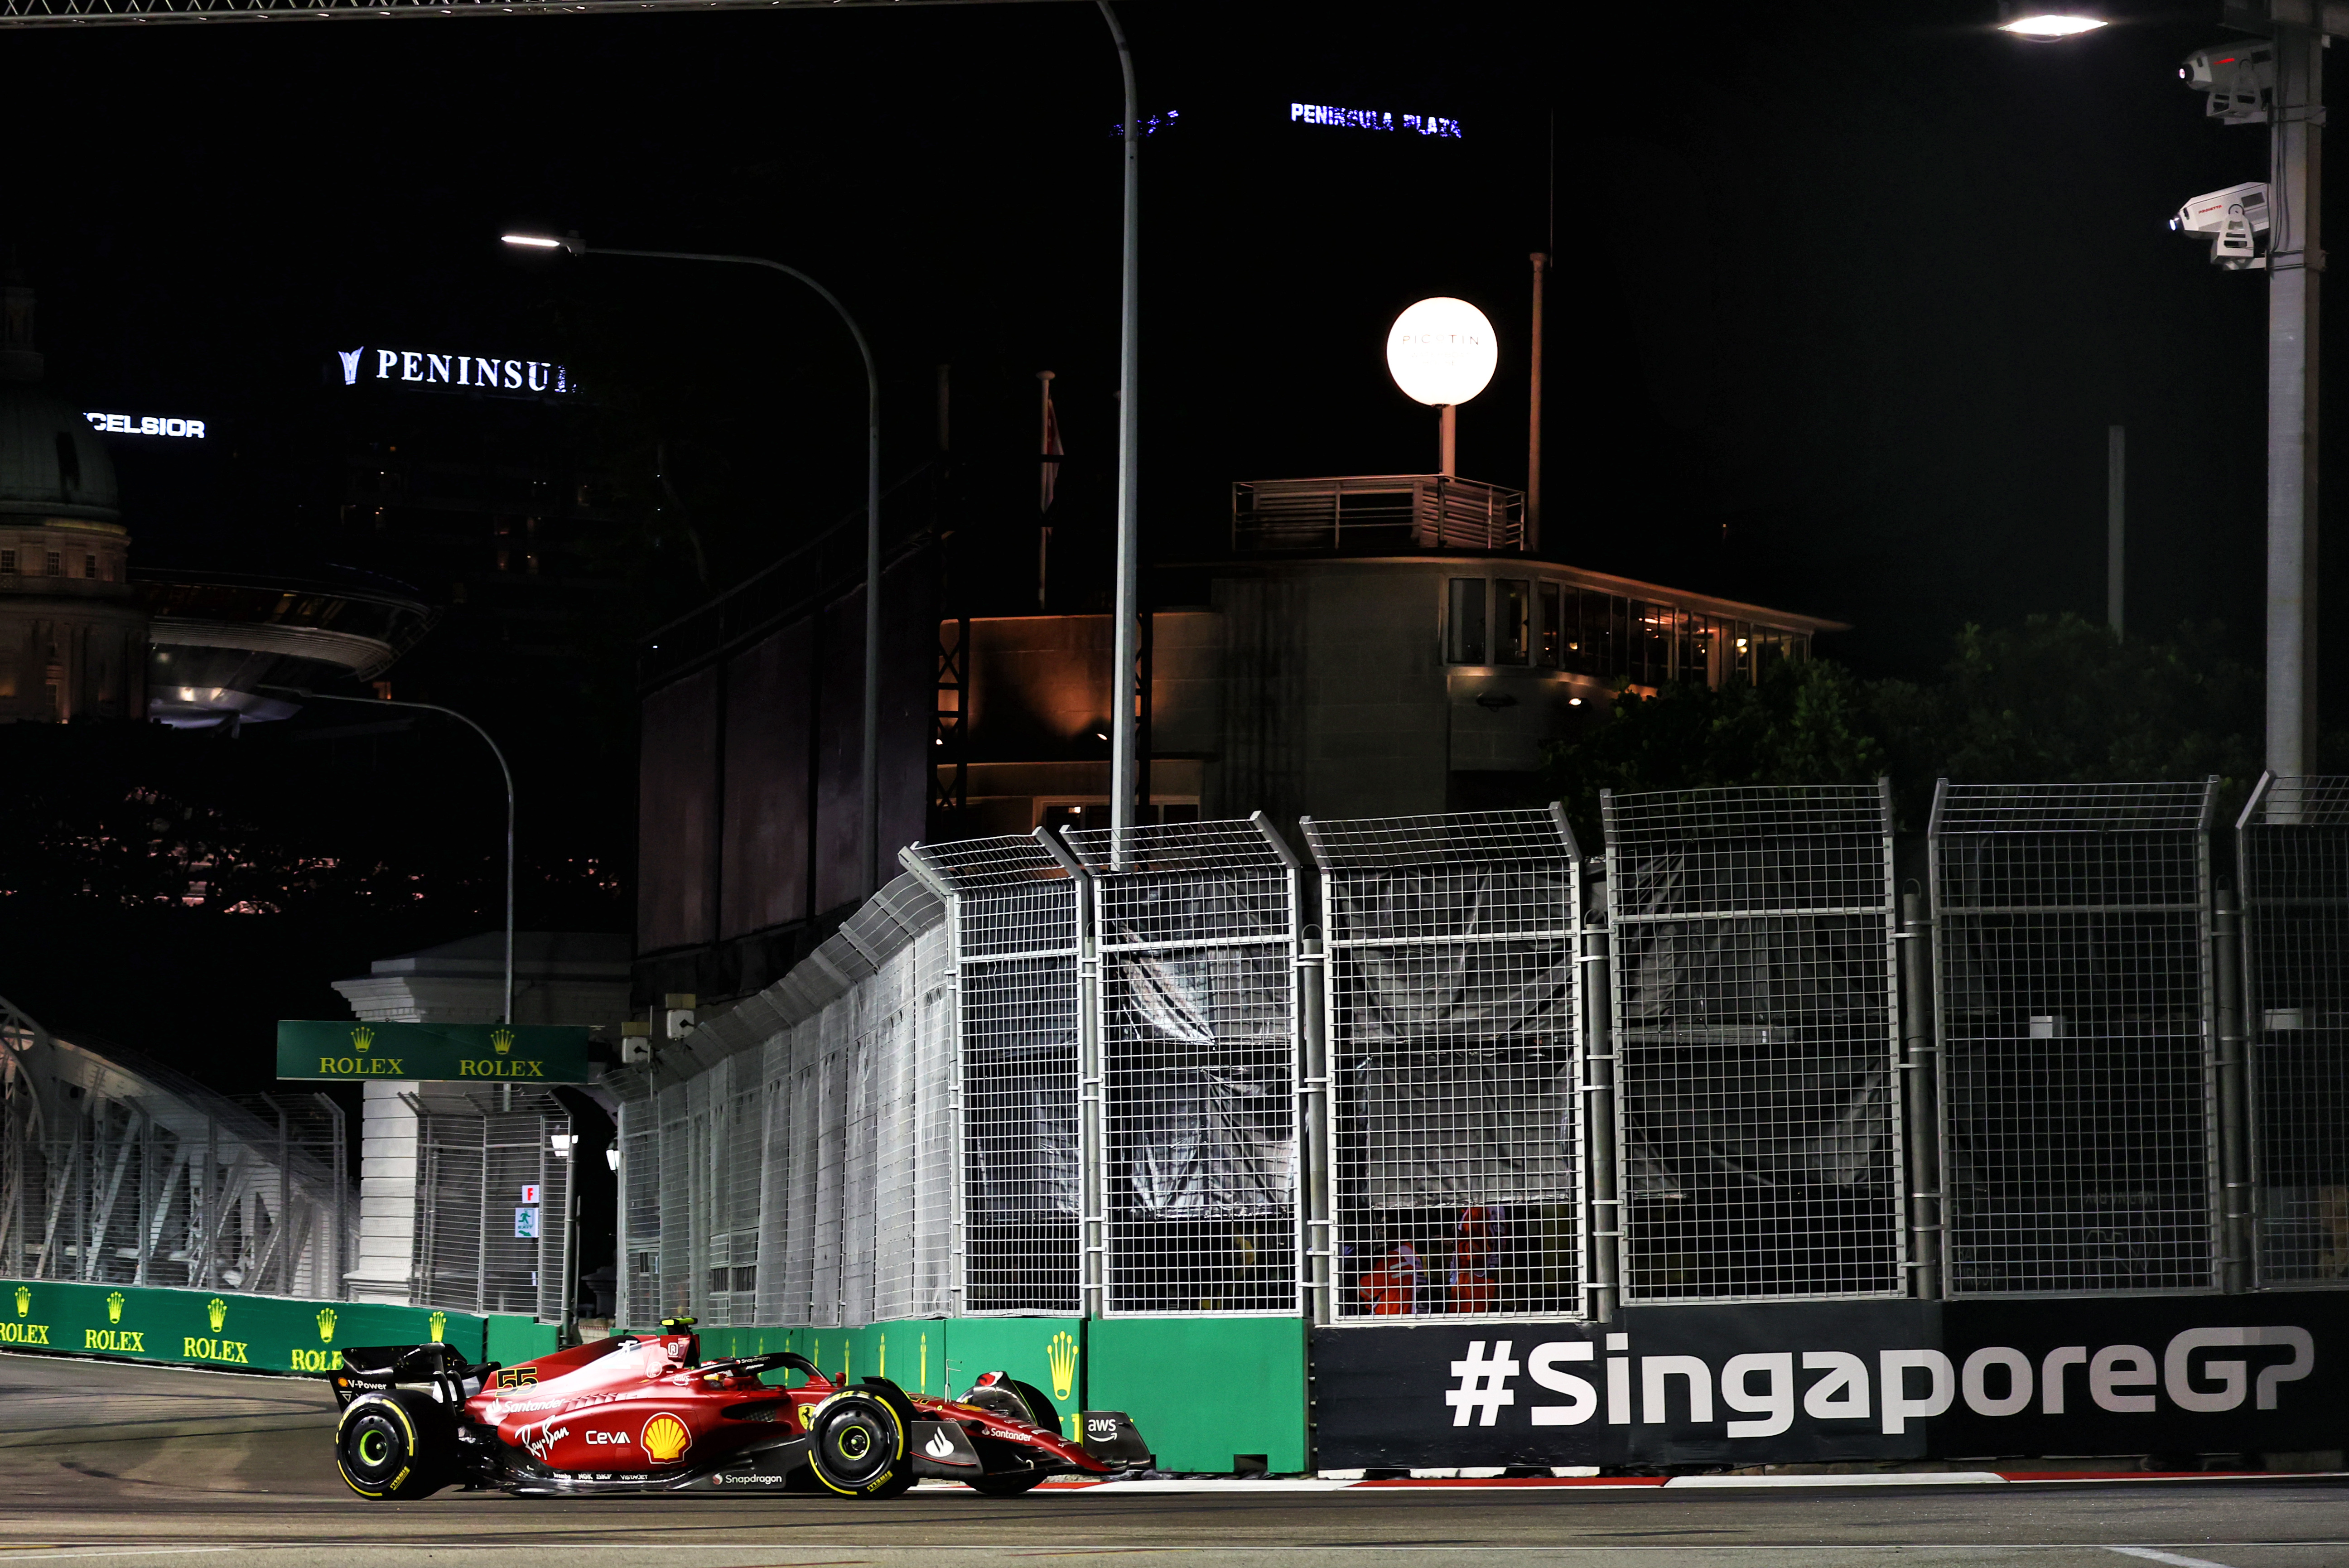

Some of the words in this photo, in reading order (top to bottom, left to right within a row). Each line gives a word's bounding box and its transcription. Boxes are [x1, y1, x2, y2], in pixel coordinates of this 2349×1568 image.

[1290, 103, 1394, 131] PENINSULA
[1403, 334, 1478, 345] PICOTIN
[376, 350, 577, 394] PENINSUL
[319, 1057, 404, 1074] ROLEX
[460, 1060, 543, 1076] ROLEX
[527, 1187, 534, 1201] F
[85, 1329, 145, 1352] ROLEX
[183, 1337, 248, 1364] ROLEX
[347, 1380, 387, 1389] V-Power
[495, 1367, 539, 1397] 55
[1445, 1326, 2314, 1437] #SingaporeGP
[502, 1398, 565, 1413] Santander
[1088, 1418, 1116, 1432] aws
[991, 1428, 1033, 1442] Santander
[725, 1474, 782, 1485] Snapdragon
